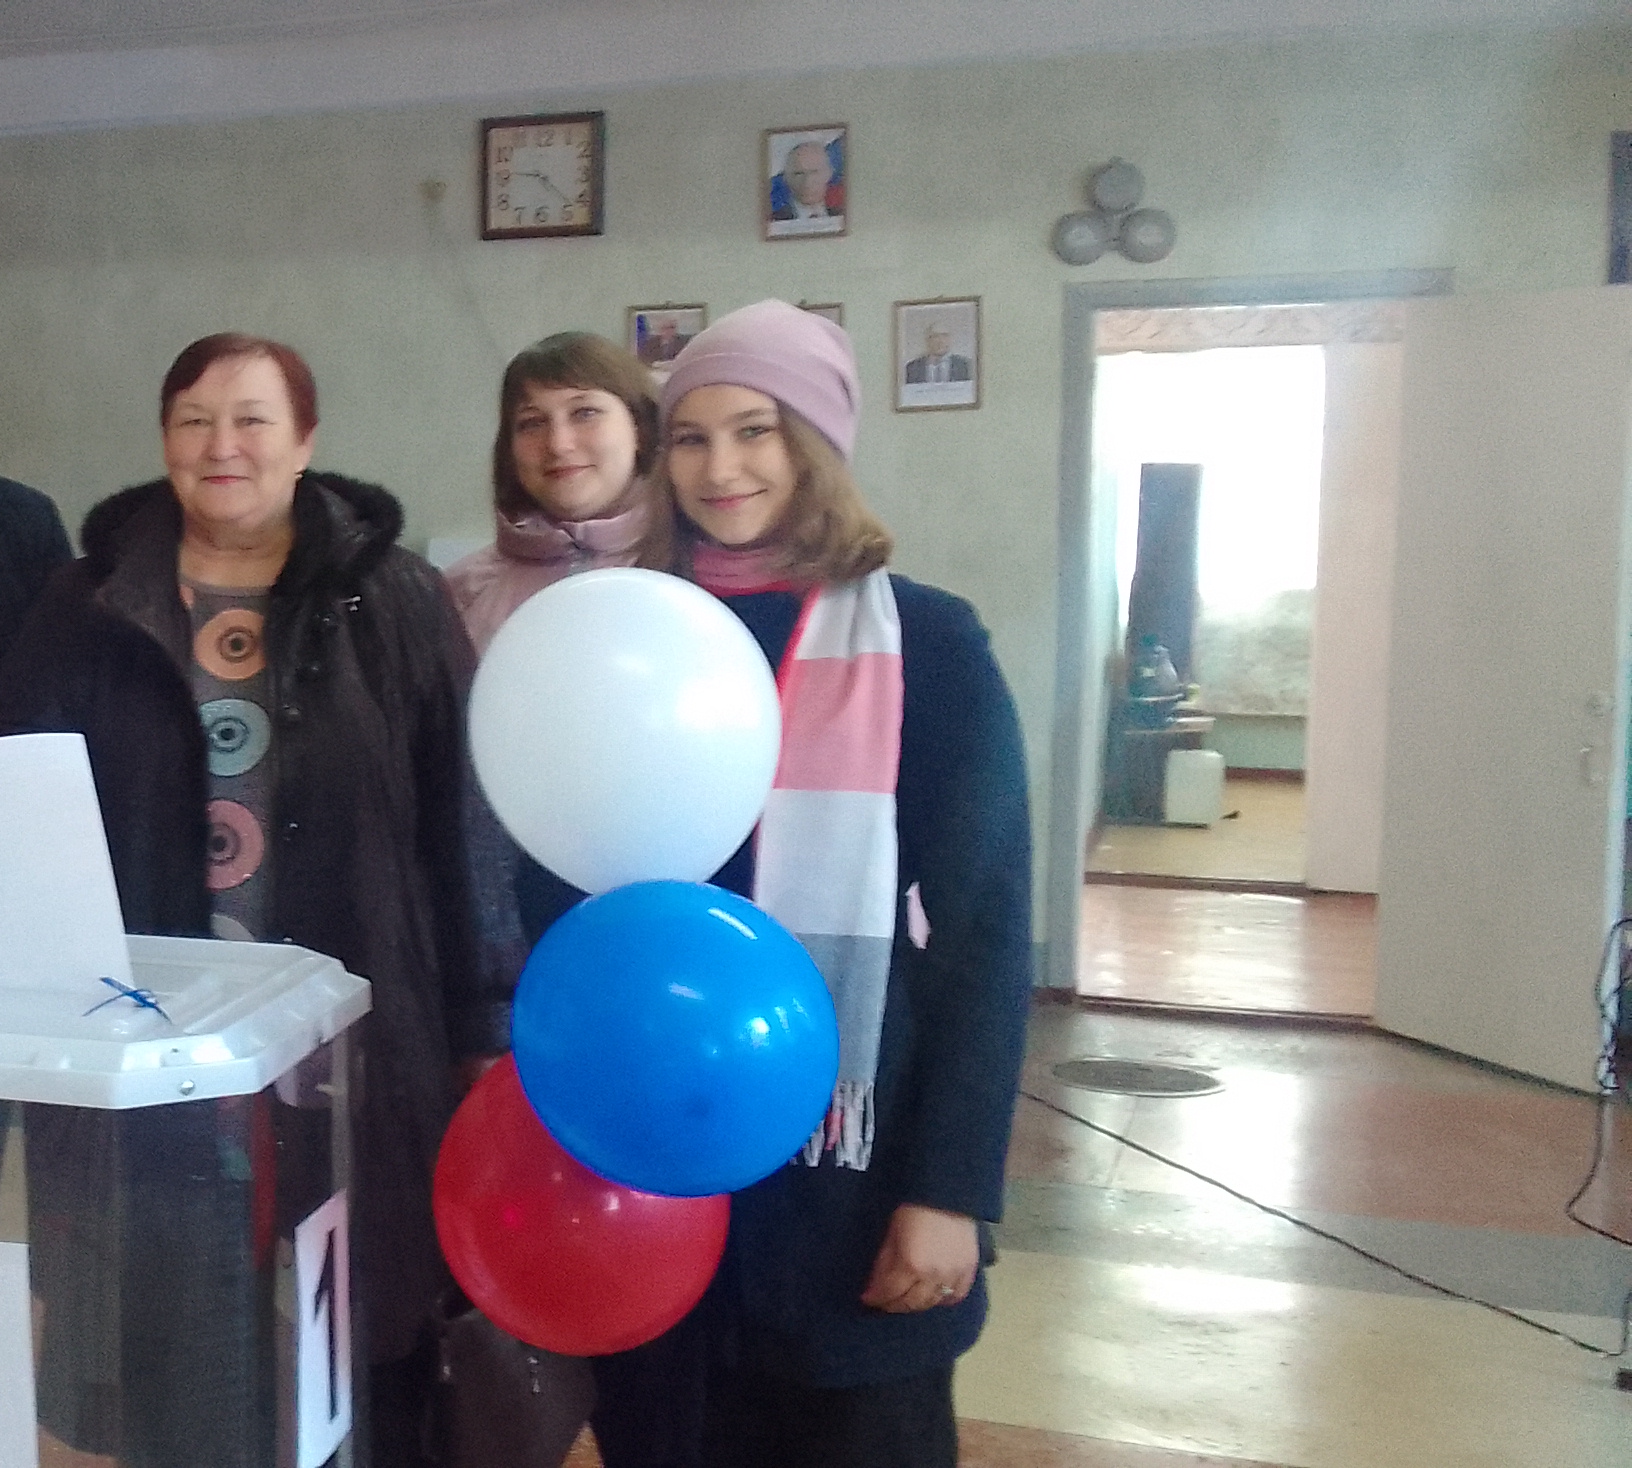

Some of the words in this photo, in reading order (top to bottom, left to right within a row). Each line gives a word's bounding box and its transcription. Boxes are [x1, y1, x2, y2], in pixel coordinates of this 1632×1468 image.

[535, 129, 554, 148] 12
[576, 141, 591, 159] 2
[495, 169, 510, 187] 9
[577, 165, 590, 183] 3
[497, 193, 510, 211] 8
[574, 189, 590, 207] 4
[514, 206, 526, 225] 7
[533, 206, 549, 223] 6
[562, 204, 574, 222] 5
[313, 1227, 339, 1423] 1
